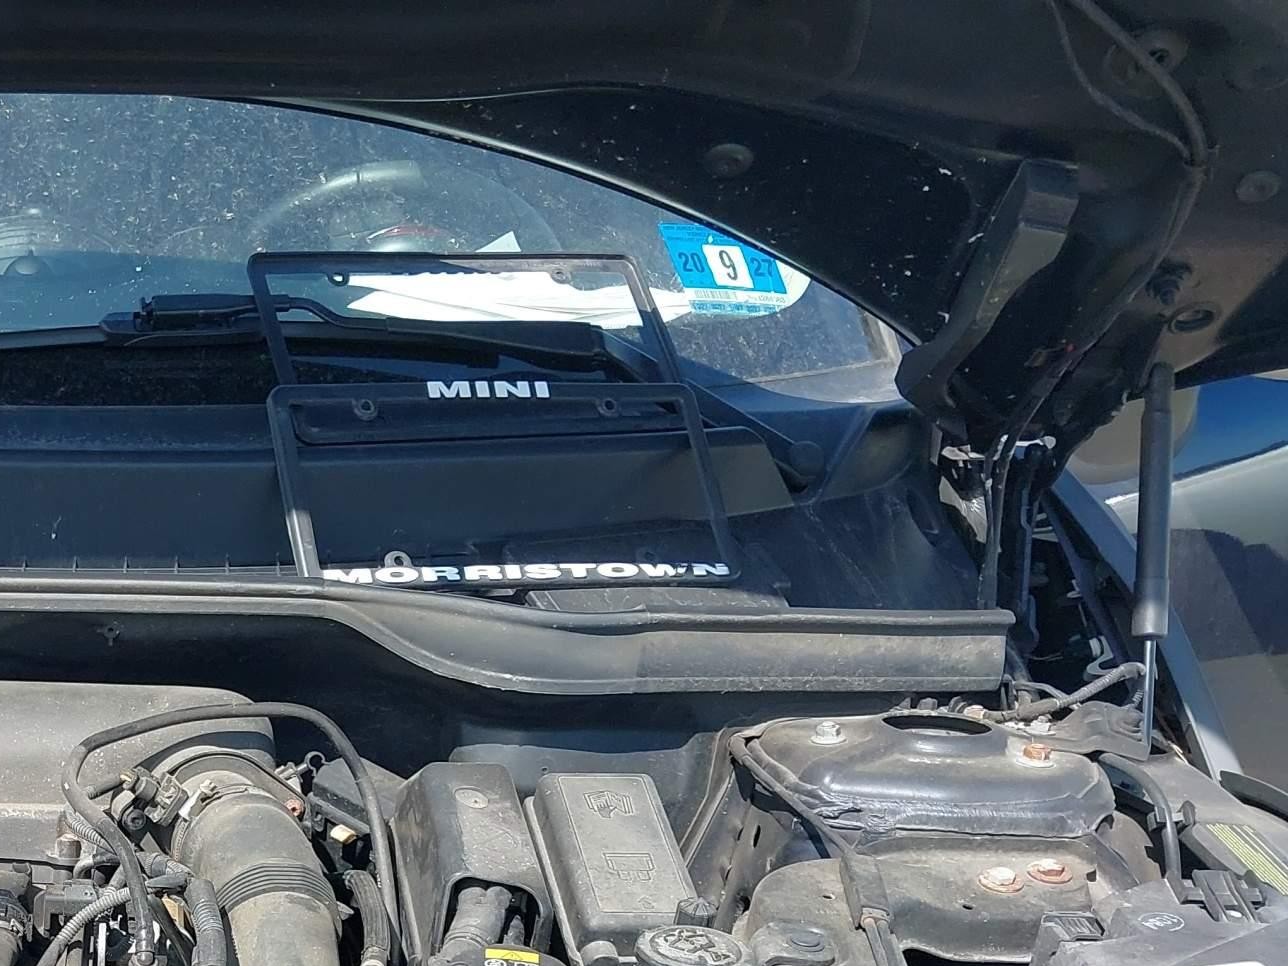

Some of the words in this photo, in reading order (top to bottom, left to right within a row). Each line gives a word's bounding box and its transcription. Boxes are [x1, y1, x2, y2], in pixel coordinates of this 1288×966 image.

[678, 252, 704, 273] 20
[718, 250, 738, 280] 9
[750, 258, 773, 277] 27
[426, 380, 551, 399] MINI
[323, 563, 730, 584] MORRISTOWN
